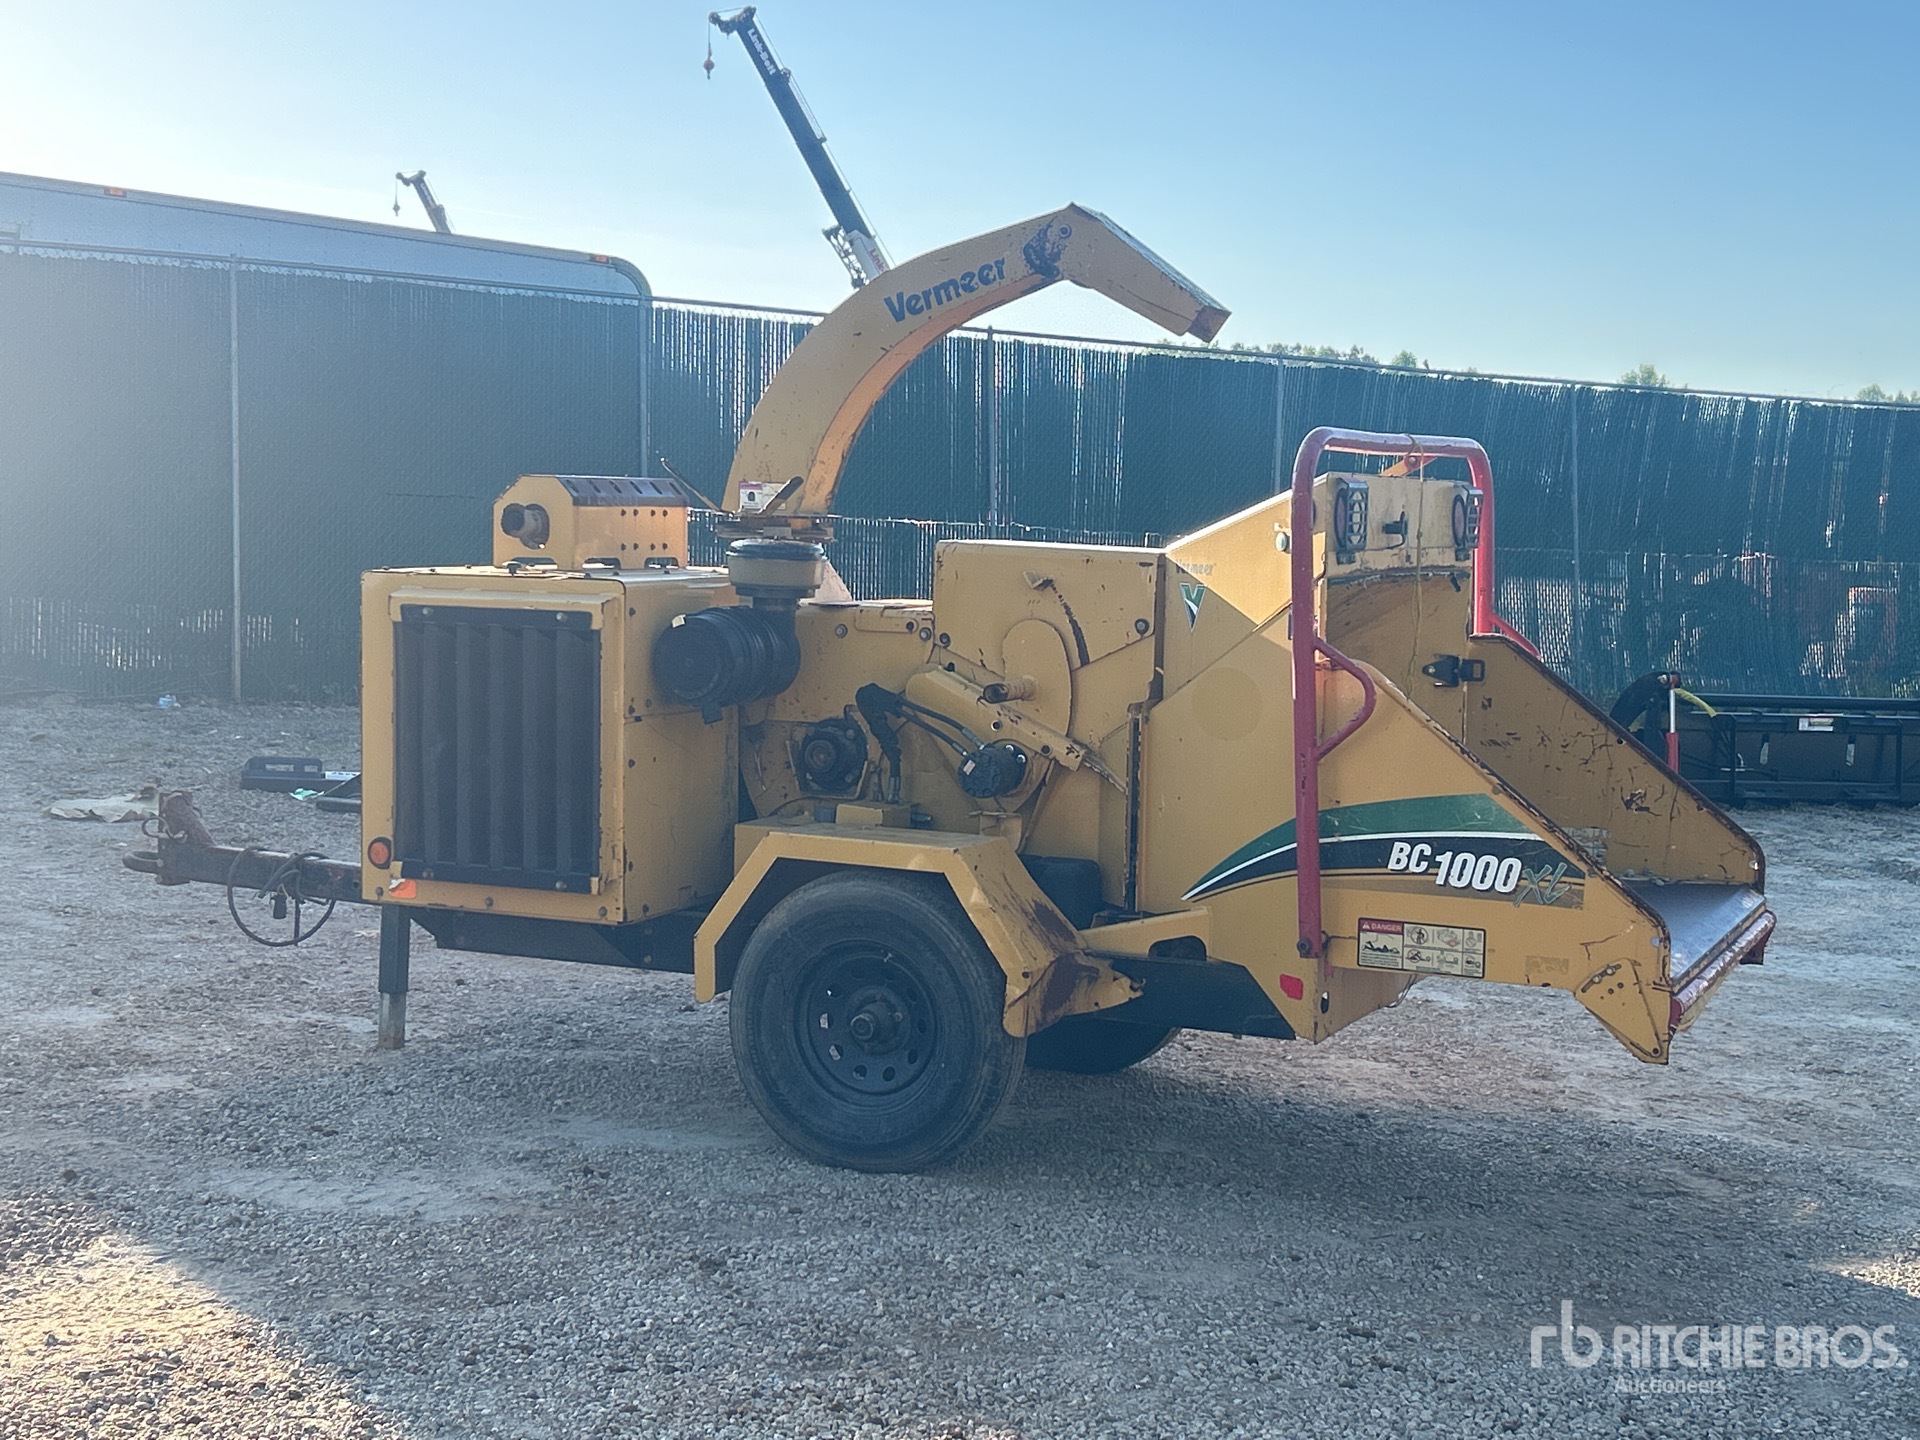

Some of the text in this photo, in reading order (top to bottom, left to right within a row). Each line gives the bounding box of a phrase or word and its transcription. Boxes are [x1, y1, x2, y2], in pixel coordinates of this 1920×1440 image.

[748, 28, 776, 75] Link-Belt
[884, 257, 1006, 323] Vermeer
[1371, 924, 1402, 933] DANGER
